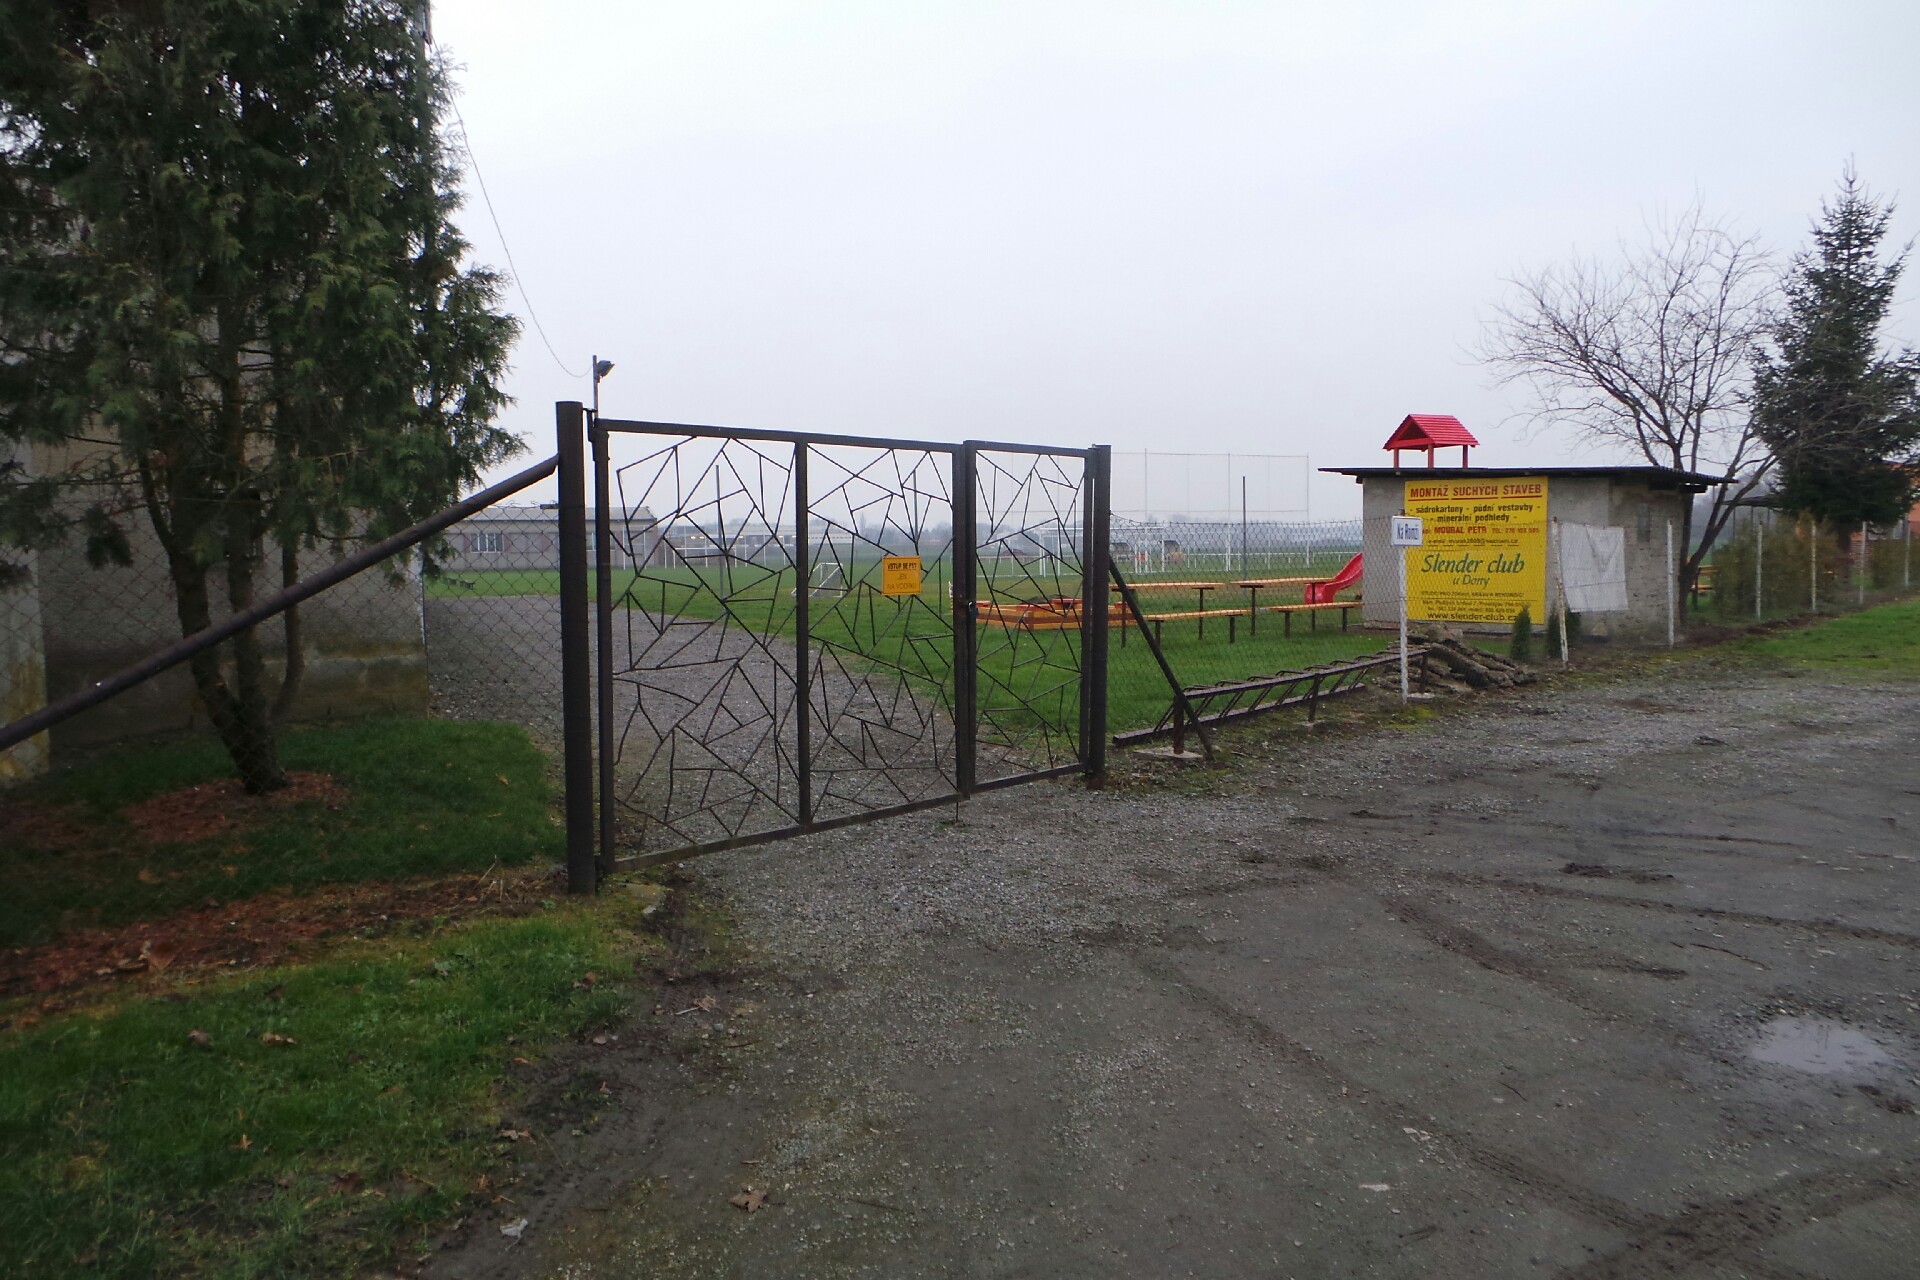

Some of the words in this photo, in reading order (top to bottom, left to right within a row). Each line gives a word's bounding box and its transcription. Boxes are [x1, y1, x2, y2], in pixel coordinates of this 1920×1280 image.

[1410, 484, 1449, 497] MONTÁŽ
[1453, 484, 1498, 496] SUCHÝCH
[1503, 484, 1542, 495] STAVEB
[1416, 505, 1463, 514] sádrokartony
[1498, 503, 1533, 513] vestavby
[1475, 513, 1510, 523] podhledy
[1468, 526, 1487, 534] PETR
[1421, 553, 1483, 573] Slender
[1487, 553, 1525, 573] club
[1453, 577, 1459, 585] u
